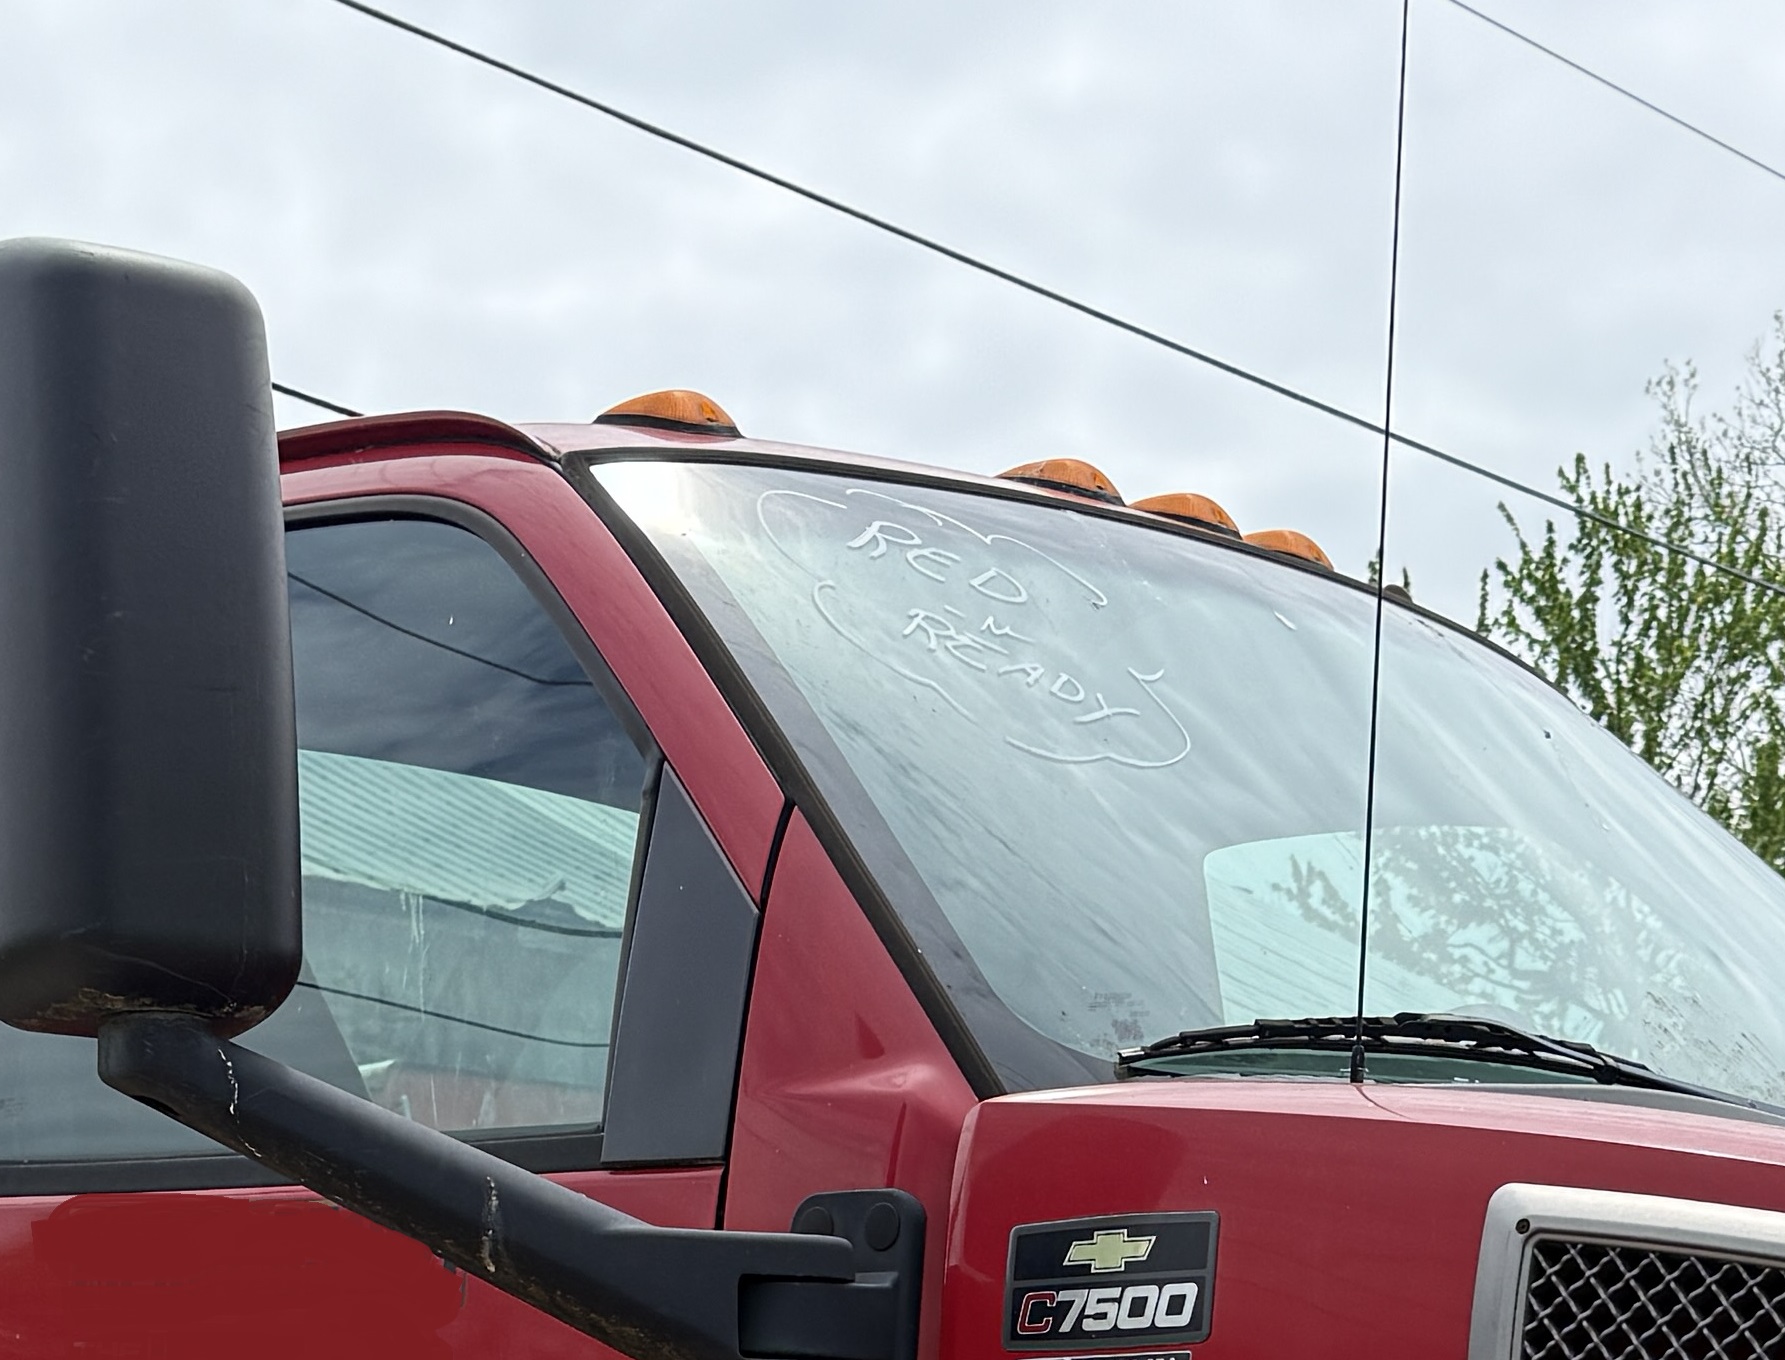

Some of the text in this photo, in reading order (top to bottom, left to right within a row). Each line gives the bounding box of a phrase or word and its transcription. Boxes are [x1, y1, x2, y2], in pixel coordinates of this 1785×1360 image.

[846, 521, 1028, 603] RED
[902, 607, 1140, 725] READY
[1017, 1282, 1199, 1335] C7500
